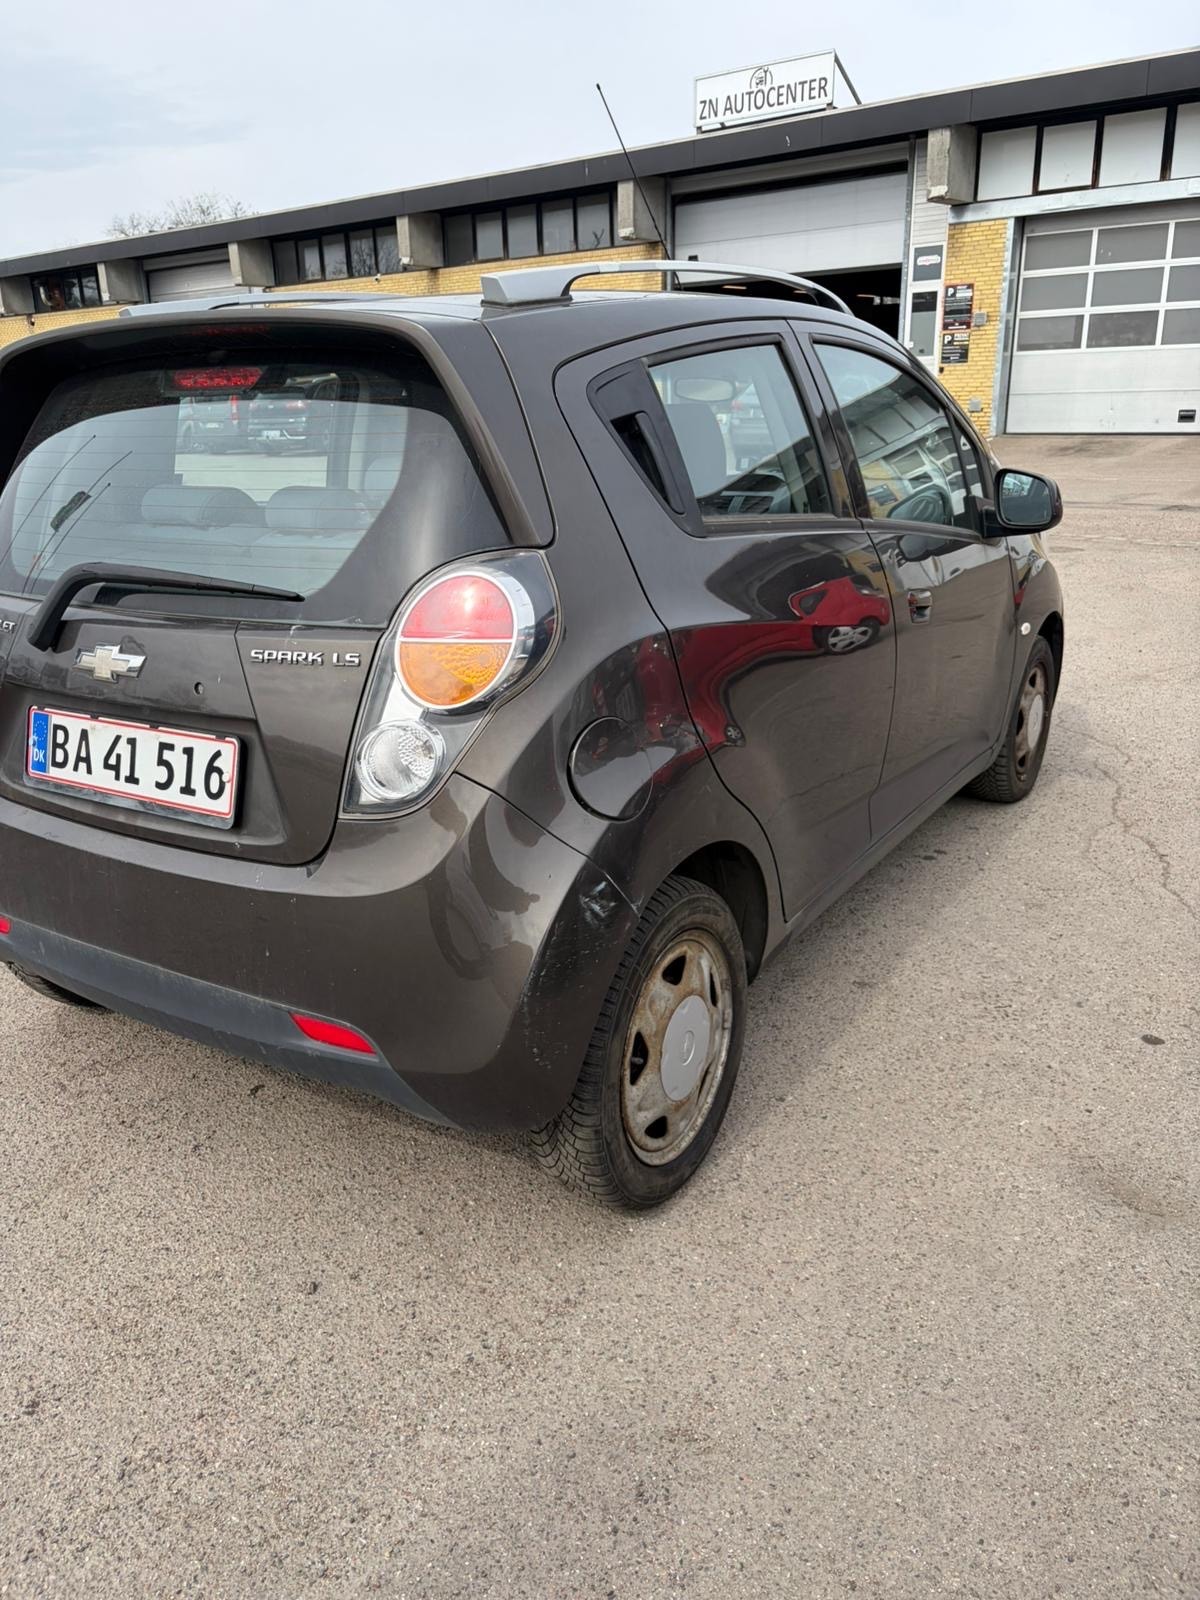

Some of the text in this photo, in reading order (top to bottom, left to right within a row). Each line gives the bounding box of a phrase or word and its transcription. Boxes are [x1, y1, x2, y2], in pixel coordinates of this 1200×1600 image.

[699, 76, 828, 120] ZN AUTOCENTER
[948, 287, 955, 296] P
[944, 335, 952, 344] P
[250, 648, 361, 667] SPARK LS
[33, 748, 45, 763] DK
[51, 723, 227, 801] BA 41 516
